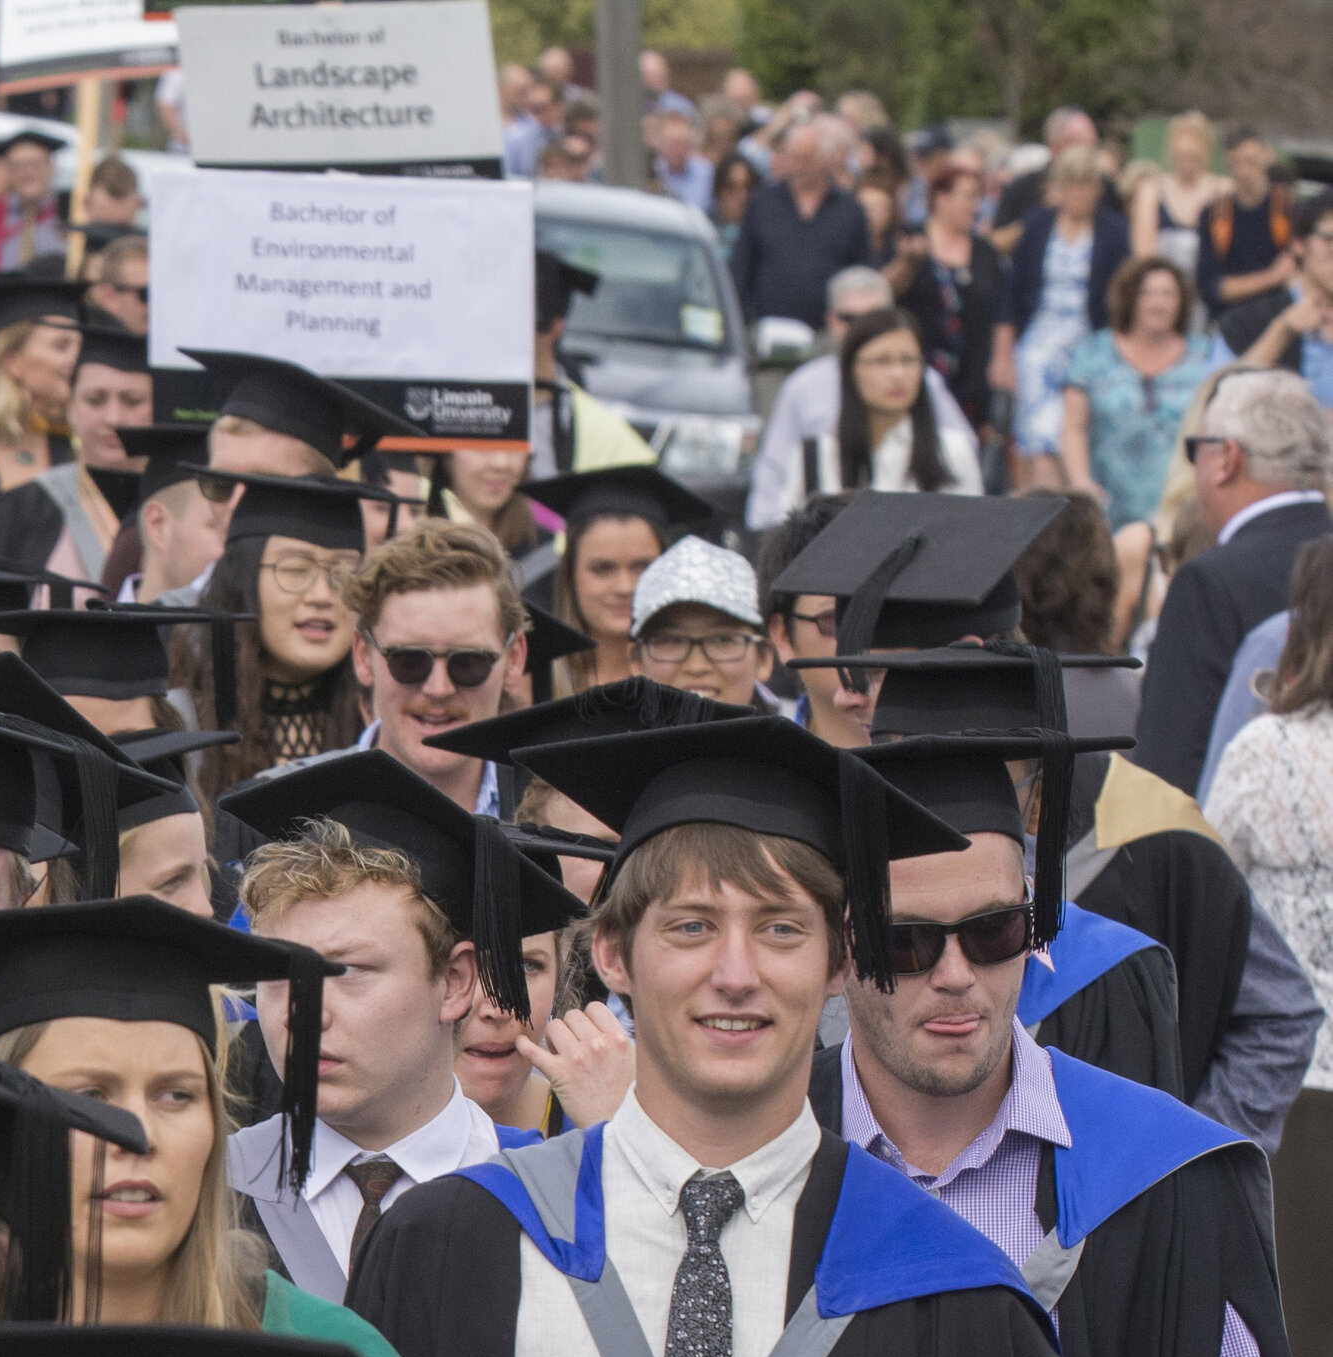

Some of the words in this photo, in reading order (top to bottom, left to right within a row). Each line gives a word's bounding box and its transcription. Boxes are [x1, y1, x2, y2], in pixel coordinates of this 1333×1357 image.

[278, 28, 361, 47] Bachelor
[367, 26, 386, 44] of
[253, 59, 418, 91] Landscape
[249, 100, 435, 131] Architecture
[270, 201, 368, 225] Bachelor
[374, 204, 397, 225] of
[251, 236, 415, 262] Environmental
[235, 272, 384, 299] Management
[390, 279, 432, 299] and
[285, 309, 382, 338] Planning
